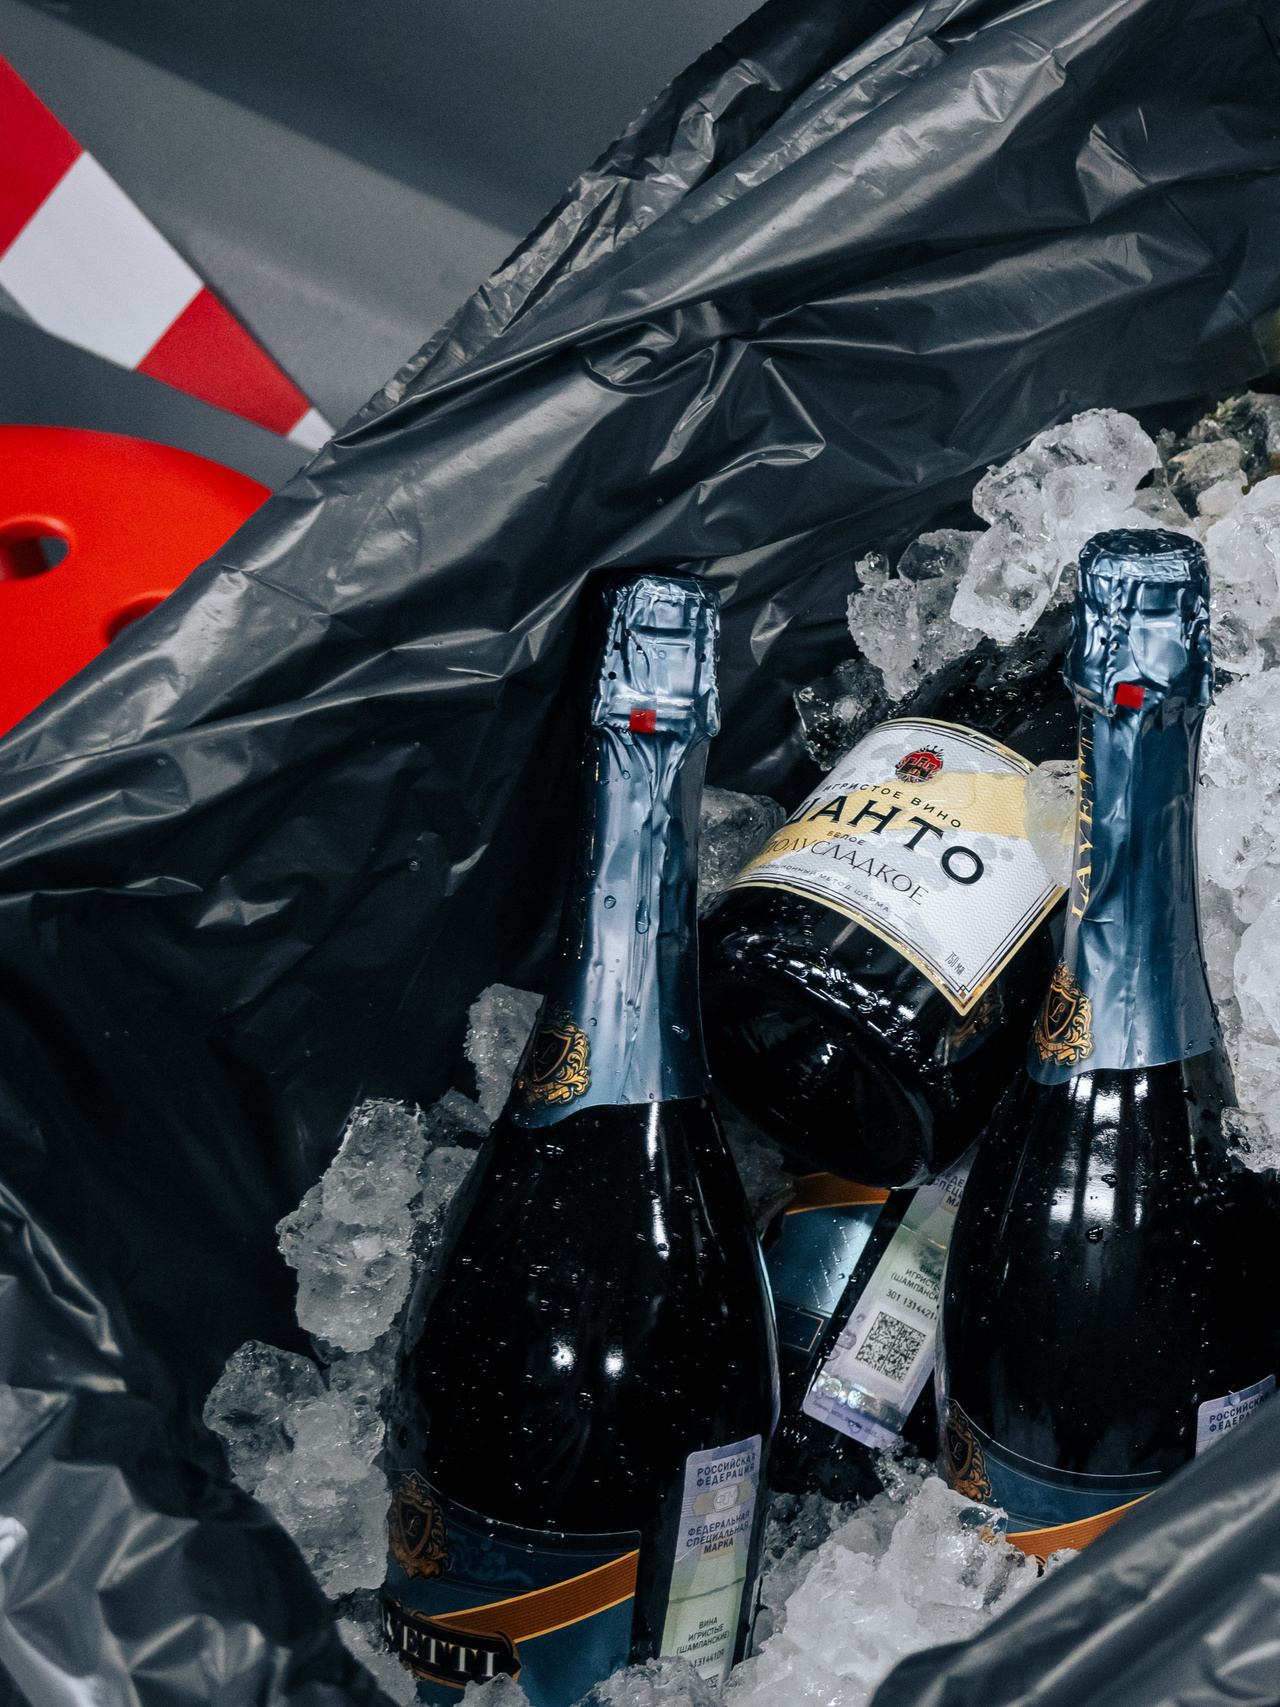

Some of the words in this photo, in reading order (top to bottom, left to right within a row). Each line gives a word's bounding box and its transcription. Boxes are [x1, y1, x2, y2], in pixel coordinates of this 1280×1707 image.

[823, 782, 904, 800] ИГРИСТОЕ
[910, 796, 962, 829] ВИНО
[826, 830, 866, 846] БЕЛОЕ
[819, 873, 852, 891] МЕТОД
[696, 1462, 755, 1487] ФЕДЕРАЦИЯ
[697, 1452, 756, 1477] РОССИЙСКАЯ
[688, 1510, 750, 1537] ФЕДЕРАЛЬНАЯ
[686, 1521, 749, 1548] СПЕЦИАЛЬНАЯ
[703, 1537, 734, 1554] МАРКА
[688, 1623, 724, 1641] ИГРИСТЫЕ
[699, 1617, 718, 1629] ВИНА
